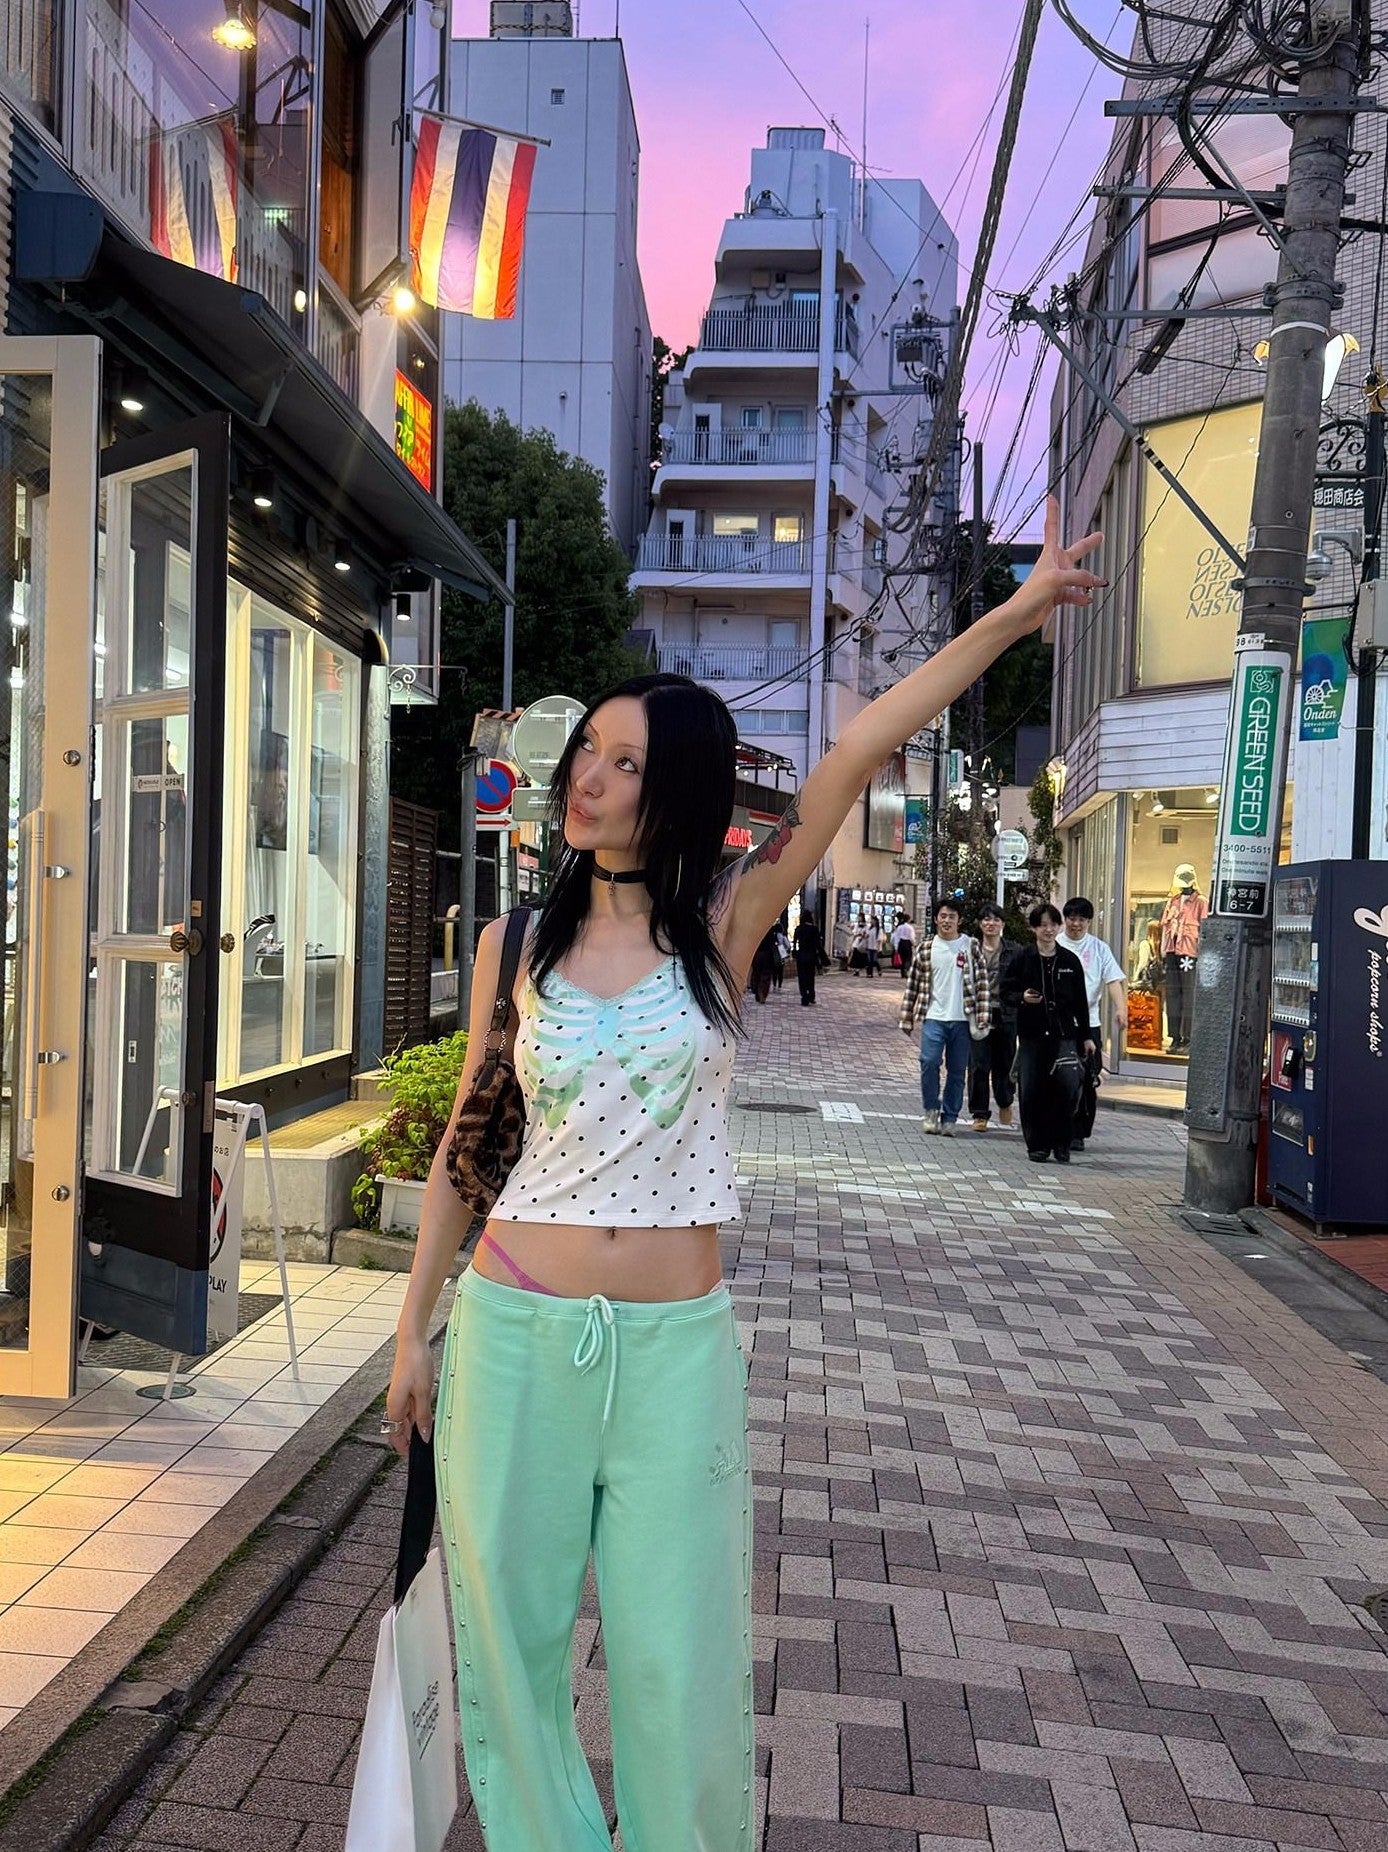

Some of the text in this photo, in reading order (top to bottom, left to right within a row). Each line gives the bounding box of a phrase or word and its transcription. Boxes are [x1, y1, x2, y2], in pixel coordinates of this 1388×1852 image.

[1303, 706, 1337, 721] Onden
[1238, 697, 1271, 832] GREEN SEED
[1229, 900, 1255, 911] 6-7
[1367, 949, 1382, 1009] popcorn
